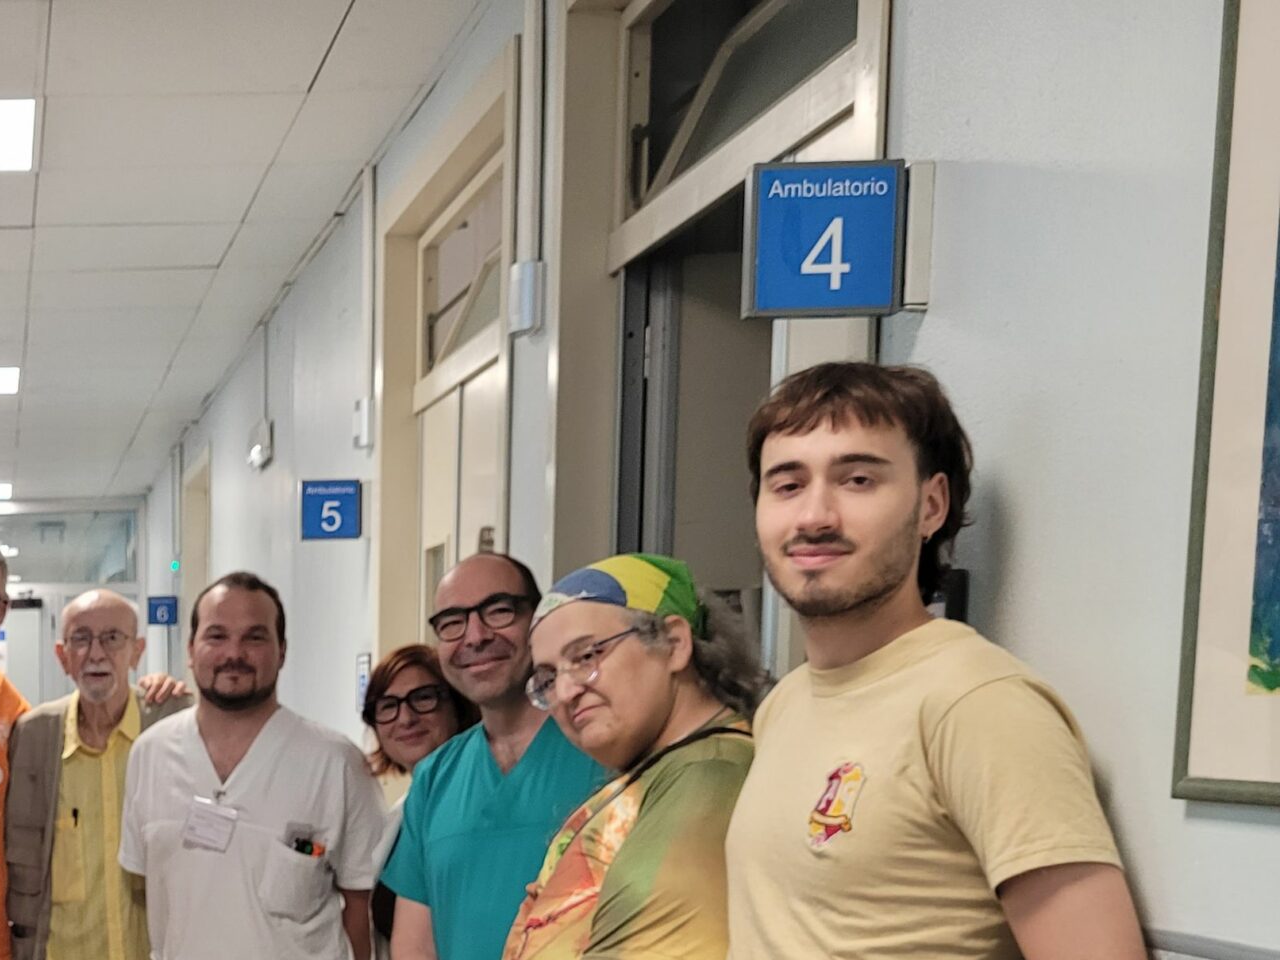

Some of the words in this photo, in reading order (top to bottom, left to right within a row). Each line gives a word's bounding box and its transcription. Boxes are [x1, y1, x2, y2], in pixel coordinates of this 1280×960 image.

[767, 176, 889, 199] Ambulatorio
[800, 216, 851, 291] 4
[320, 500, 342, 532] 5
